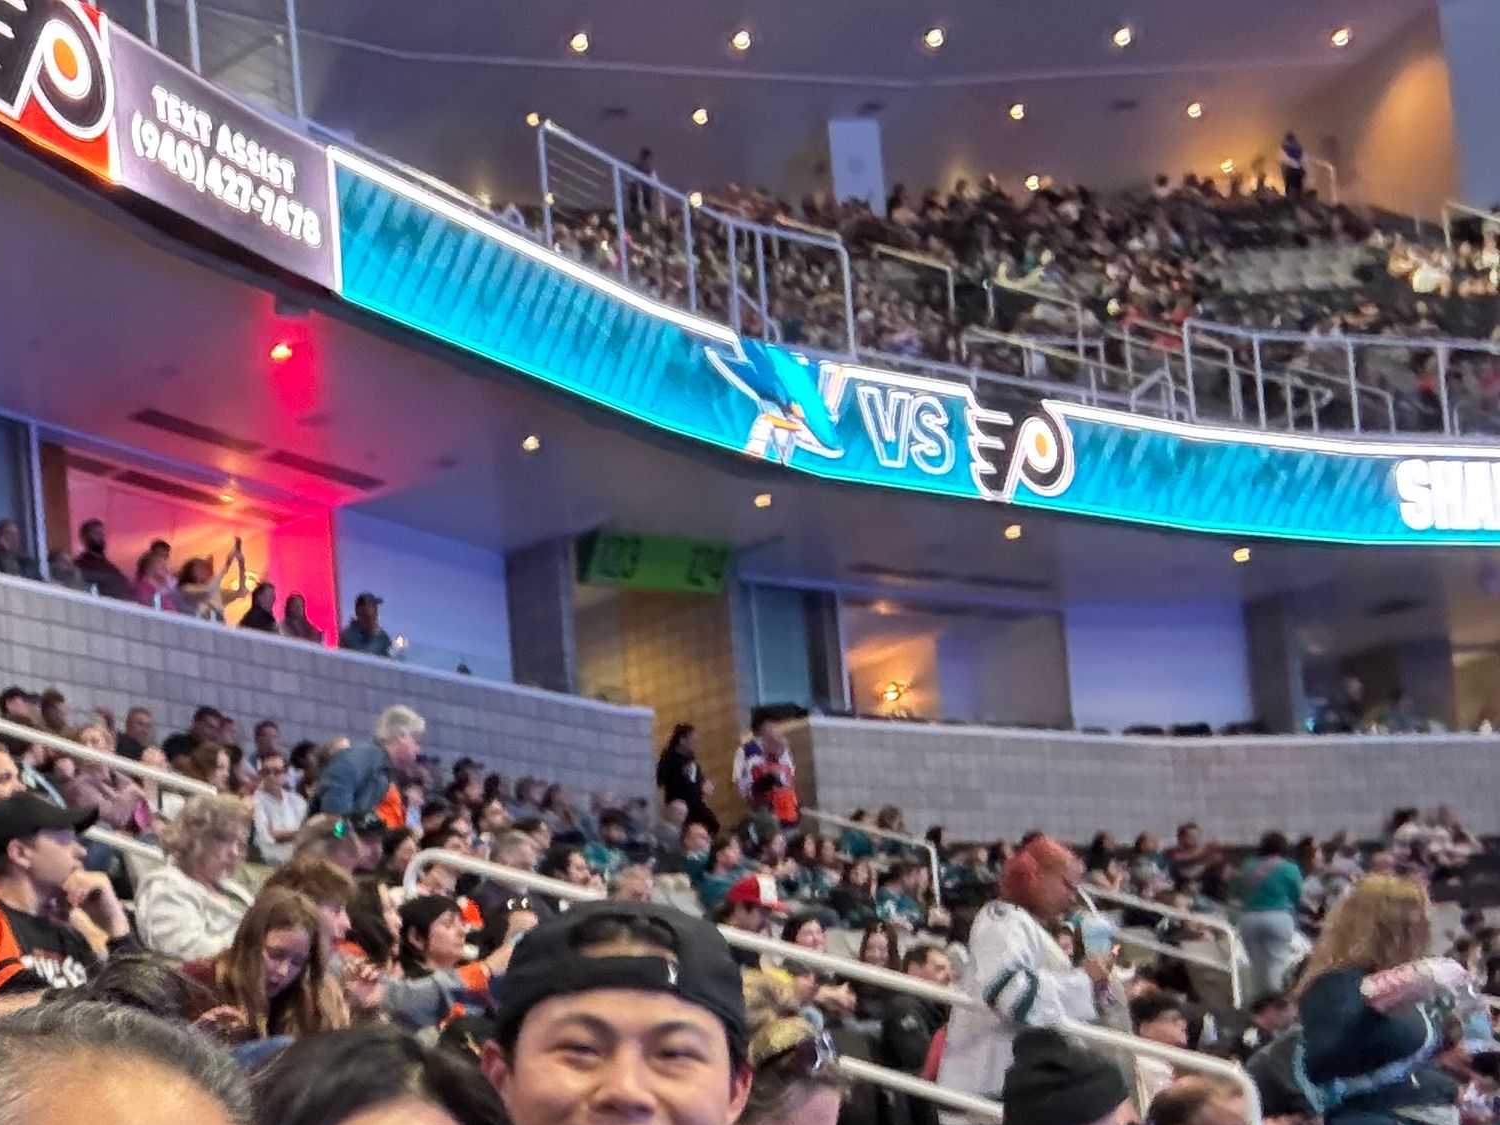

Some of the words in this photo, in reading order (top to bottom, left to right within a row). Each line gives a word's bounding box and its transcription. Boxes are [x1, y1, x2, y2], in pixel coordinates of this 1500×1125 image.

[151, 84, 213, 147] TEXT
[216, 124, 296, 194] ASSIST
[856, 384, 957, 476] VS
[1395, 458, 1500, 531] SHA
